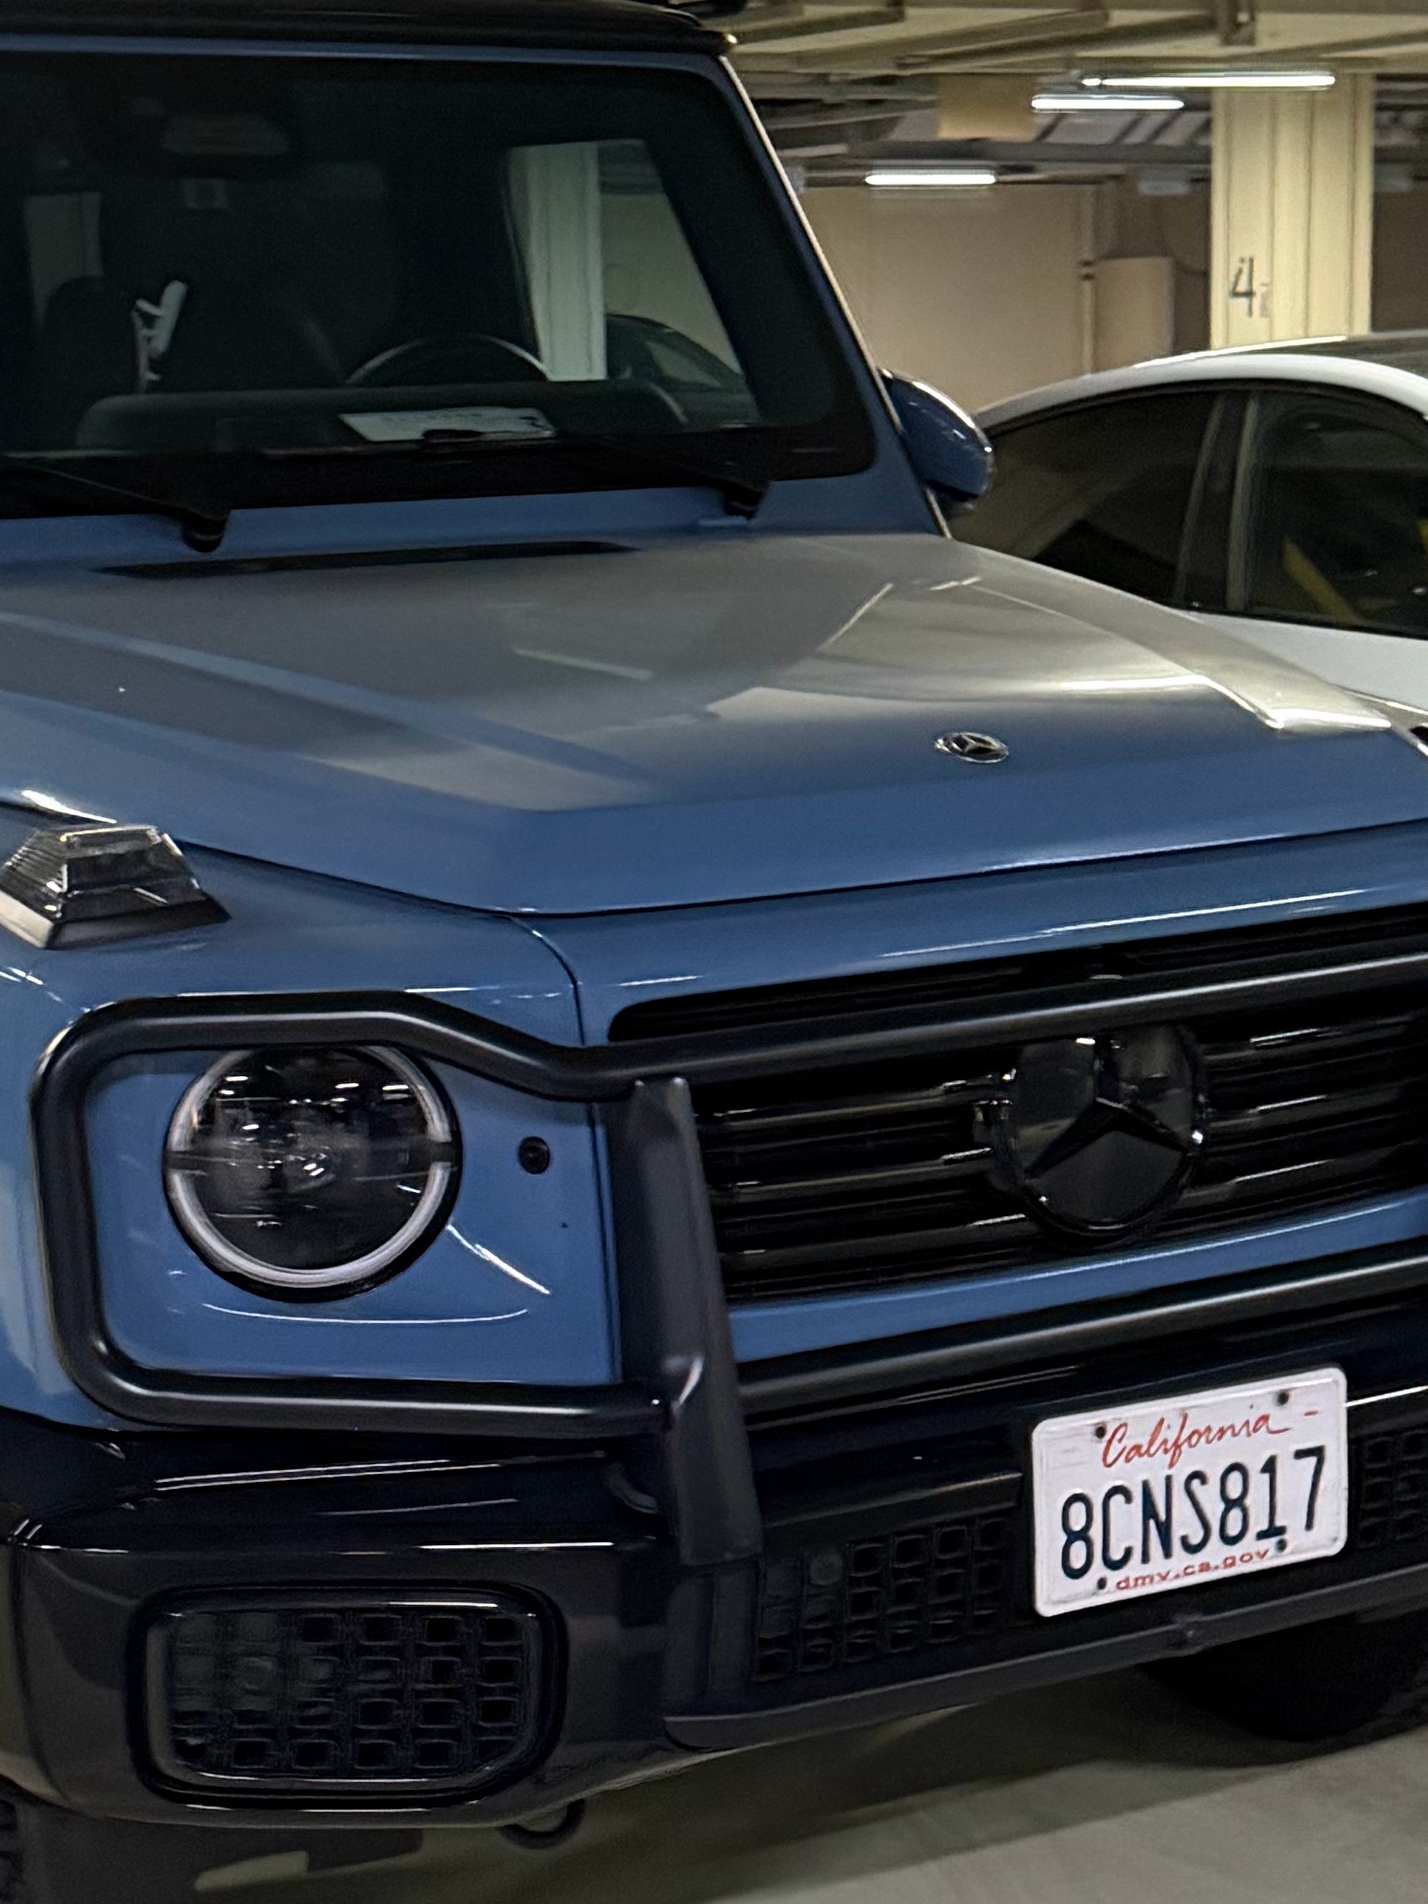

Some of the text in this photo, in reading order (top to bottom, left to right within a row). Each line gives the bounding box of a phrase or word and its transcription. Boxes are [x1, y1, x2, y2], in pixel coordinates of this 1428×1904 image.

[1101, 1411, 1291, 1469] California
[1061, 1445, 1326, 1580] 8CNS817
[1116, 1548, 1270, 1591] dmv.ca.gov
